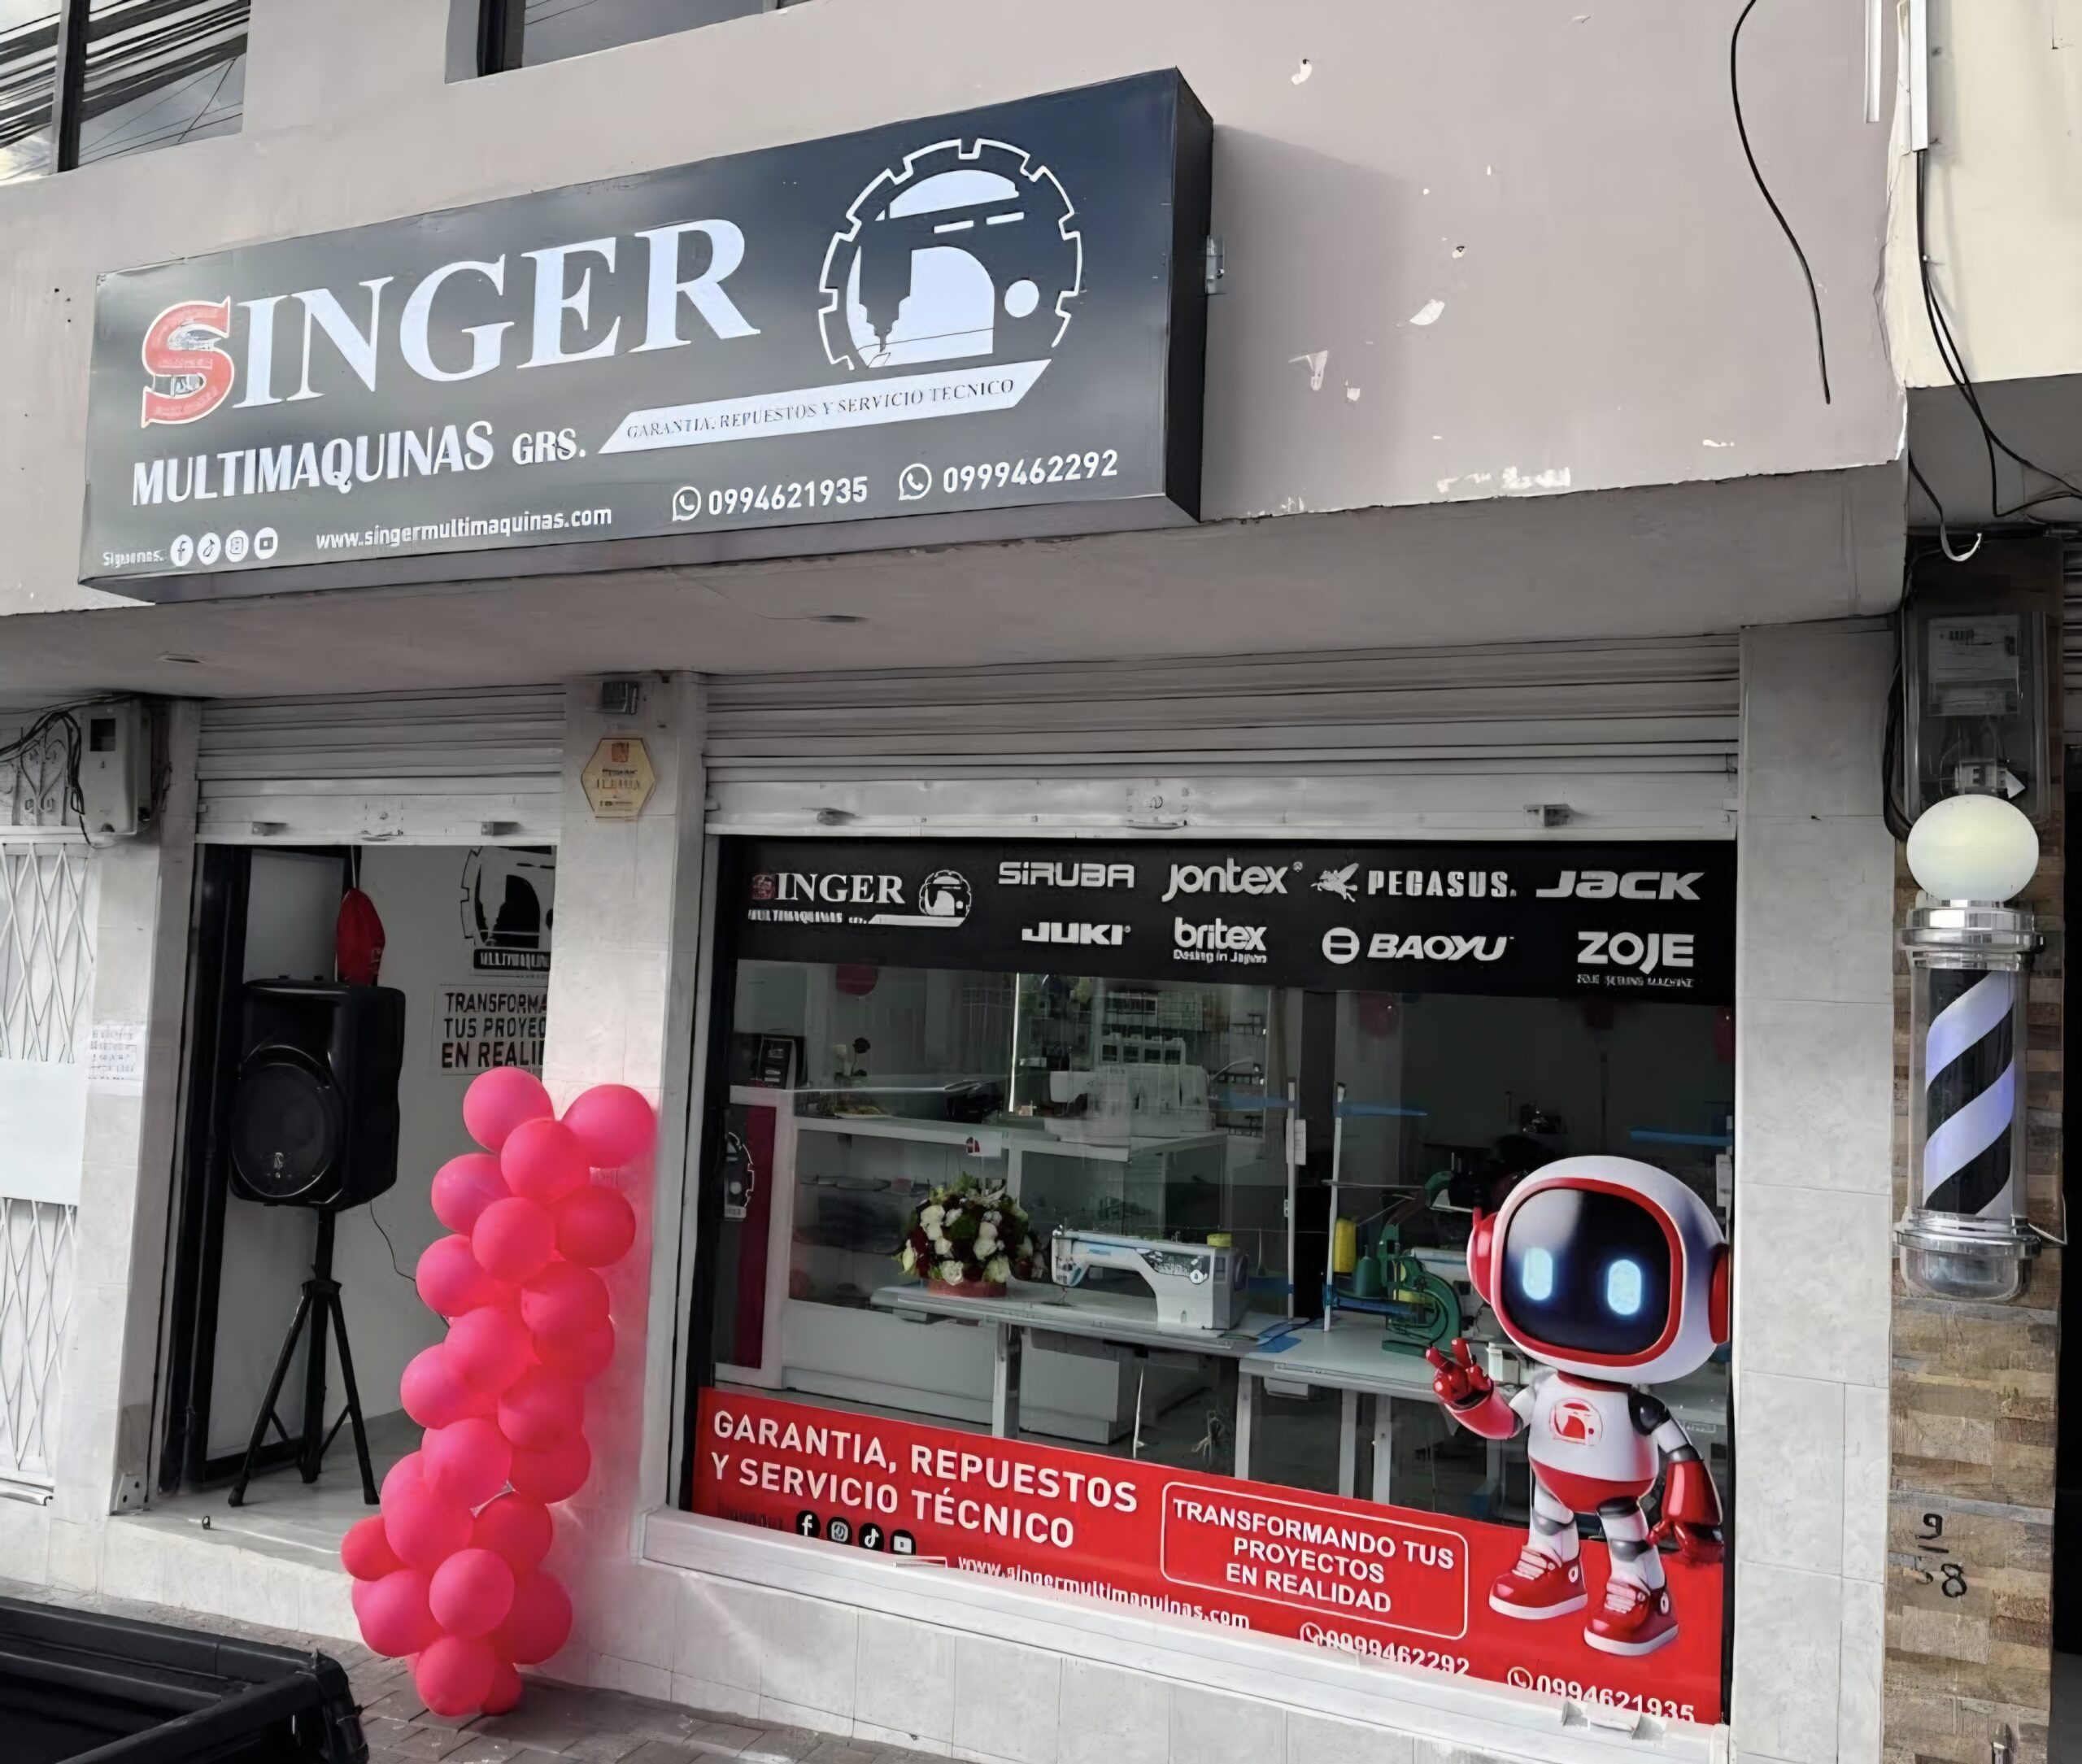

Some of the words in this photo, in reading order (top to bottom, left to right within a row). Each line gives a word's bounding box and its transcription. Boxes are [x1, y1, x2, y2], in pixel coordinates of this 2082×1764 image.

[141, 219, 761, 429] SINGER
[719, 403, 817, 429] REPUESTOS
[837, 389, 924, 412] SERVICIO
[928, 379, 1014, 402] TECNICO
[133, 420, 494, 506] MULTIMAQUINAS
[512, 428, 586, 465] GRS.
[943, 449, 1118, 494] 0999462292
[708, 476, 868, 516] 0994621935
[316, 507, 612, 550] www.singermultimaquinas.com
[751, 873, 905, 904] SINGER
[1174, 917, 1267, 951] britex
[1577, 931, 1694, 975] ZOJE
[444, 1018, 476, 1039] TUS
[442, 1041, 469, 1068] EN
[714, 1409, 897, 1474] GARANTIA,
[911, 1444, 1138, 1513] REPUESTOS
[711, 1451, 730, 1481] Y
[738, 1458, 898, 1514] SERVICIO
[911, 1487, 1074, 1548] TÉCNICO
[1173, 1498, 1395, 1558] TRANSFORMANDO
[1402, 1540, 1454, 1570] TUS
[1234, 1538, 1385, 1584] PROYECTOS
[1226, 1562, 1257, 1584] EN
[1265, 1570, 1392, 1614] REALIDAD
